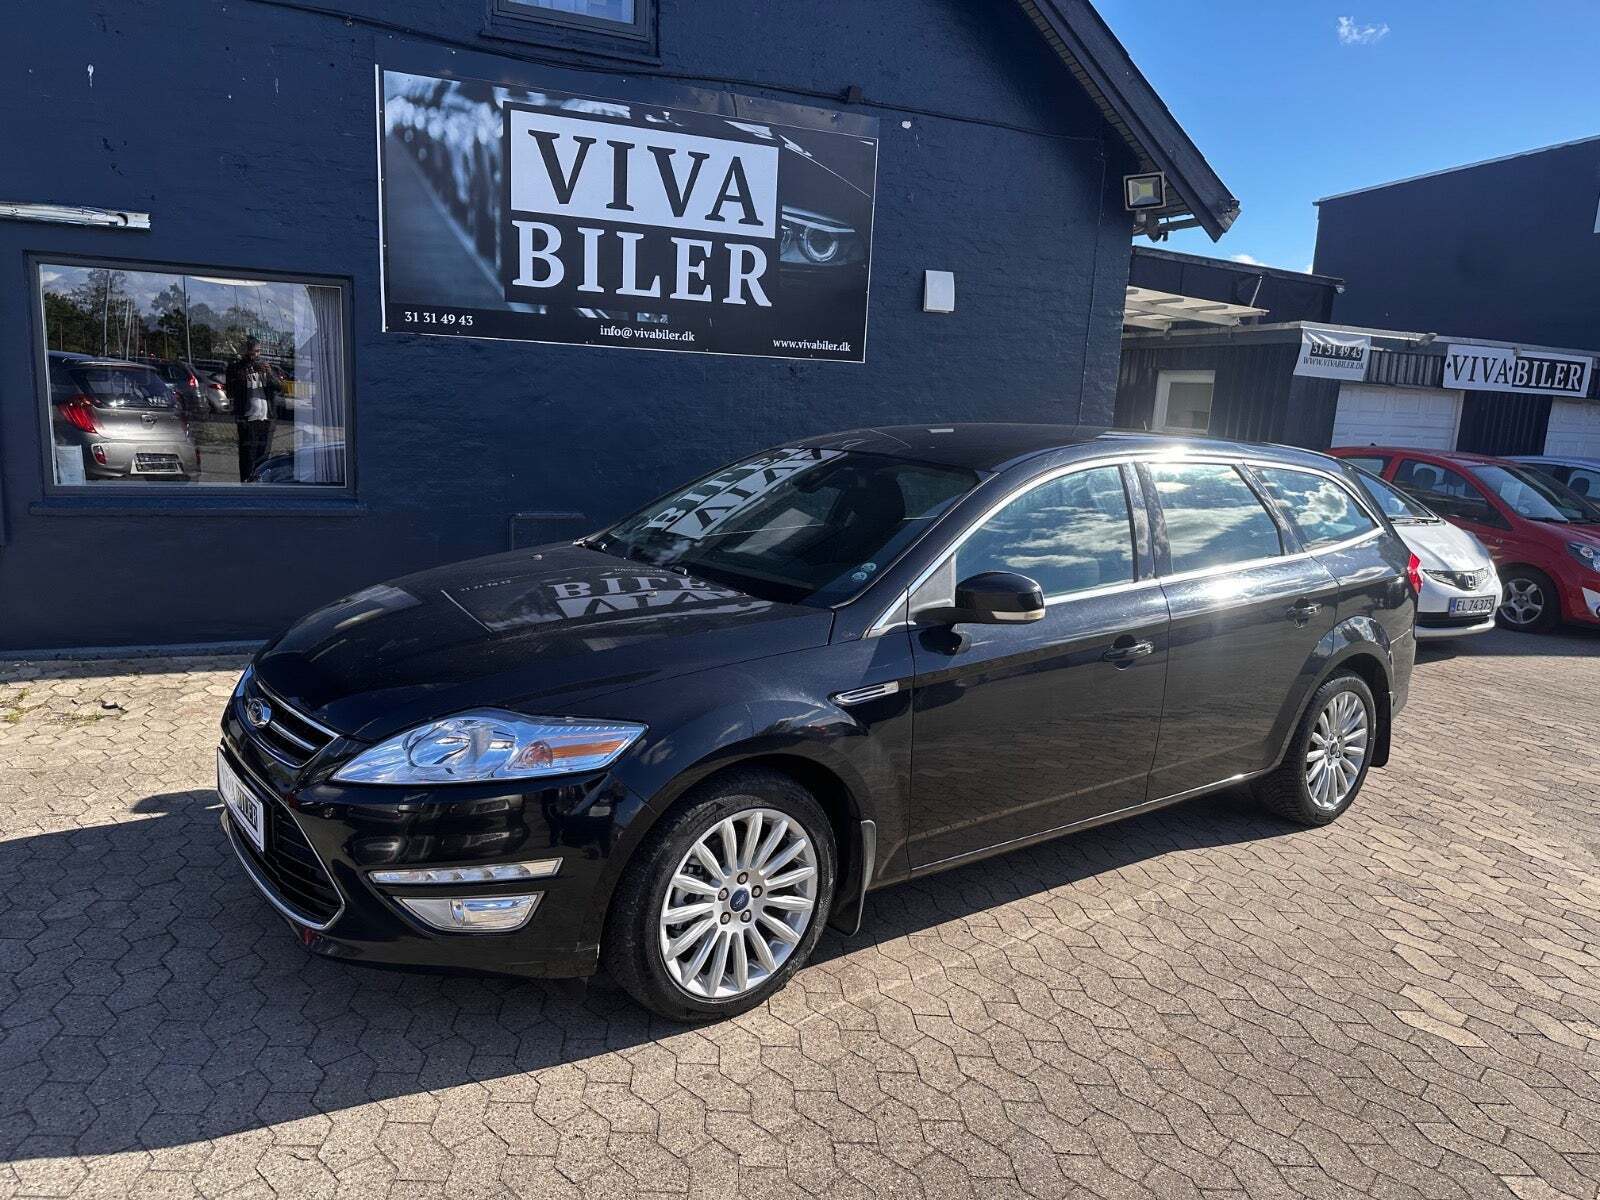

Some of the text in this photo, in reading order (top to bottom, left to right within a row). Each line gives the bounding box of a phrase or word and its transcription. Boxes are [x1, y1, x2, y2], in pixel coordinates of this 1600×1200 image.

[527, 129, 765, 227] VIVA
[511, 219, 773, 308] BILER
[404, 311, 474, 326] 31 31 49 43
[772, 339, 852, 352] www.vivabiler.dk
[1451, 354, 1582, 391] VIVA BILER
[1456, 600, 1467, 612] EL
